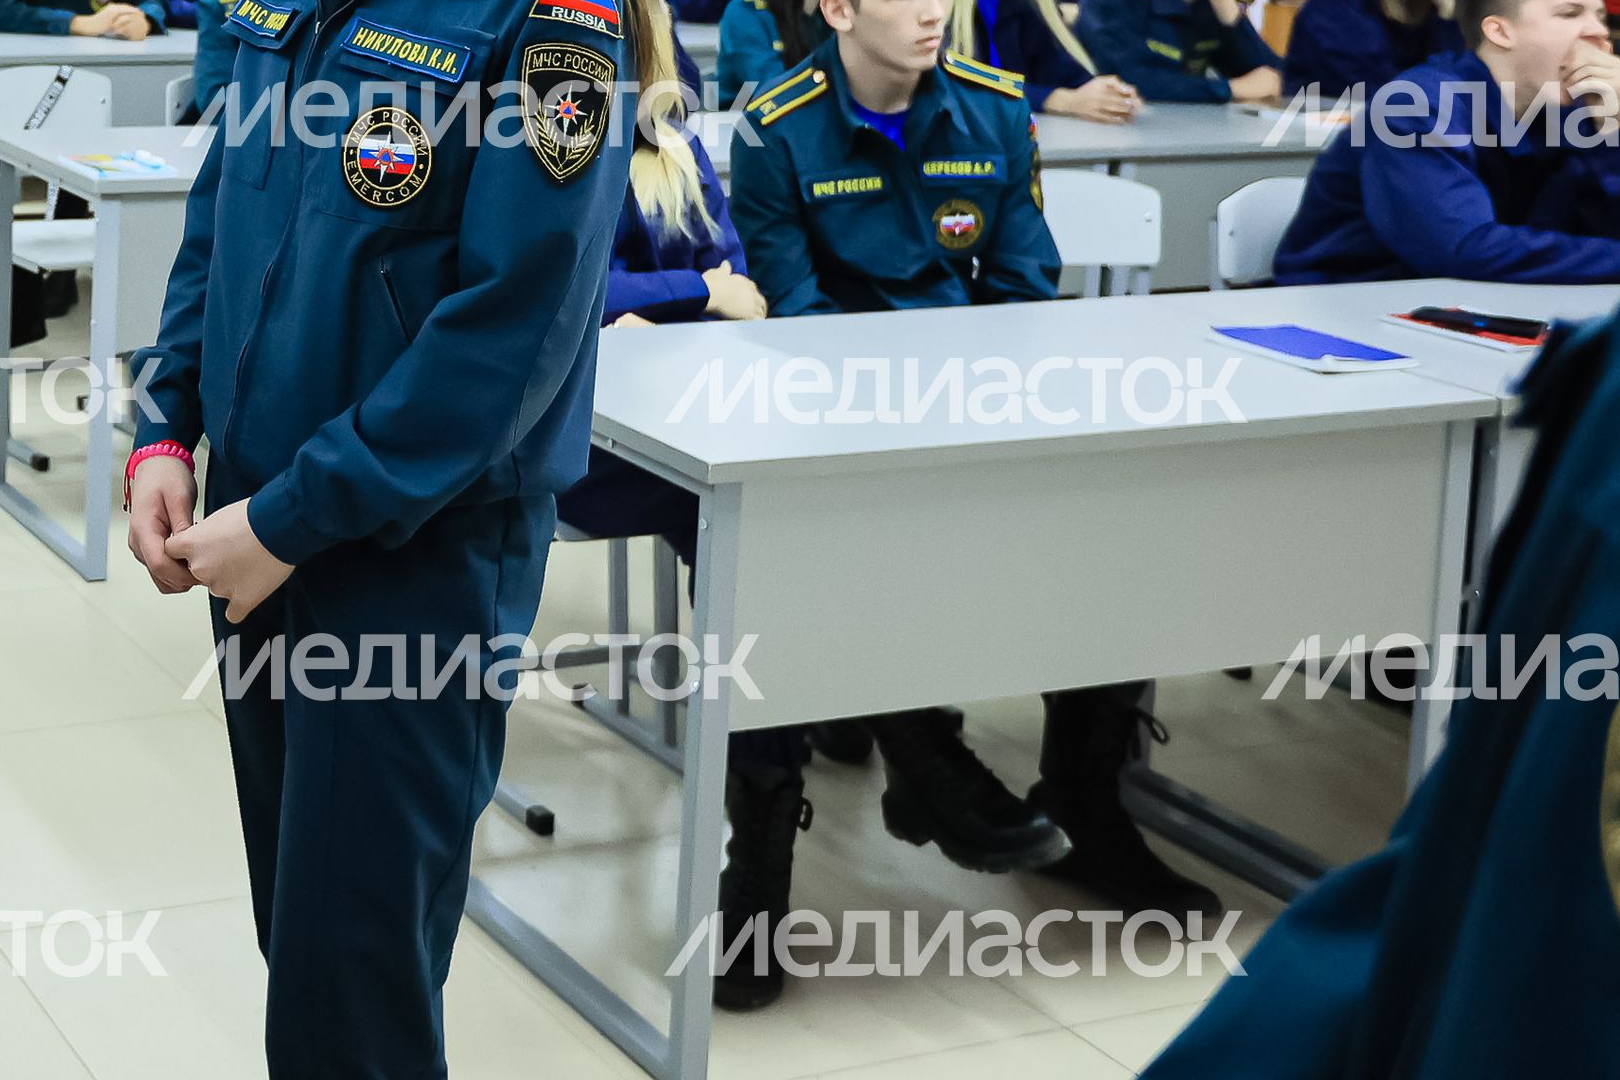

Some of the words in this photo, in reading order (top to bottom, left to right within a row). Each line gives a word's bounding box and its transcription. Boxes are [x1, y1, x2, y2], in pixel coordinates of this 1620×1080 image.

[237, 0, 268, 25] МЧС
[551, 6, 607, 31] RUSSIA
[352, 27, 429, 65] НИКУЛОВА
[426, 48, 457, 75] К.И.
[532, 52, 561, 68] МЧС
[564, 53, 609, 83] РОССИИ
[350, 115, 375, 144] МЧС
[382, 111, 428, 156] РОССИИ
[347, 160, 423, 202] EMERCOM
